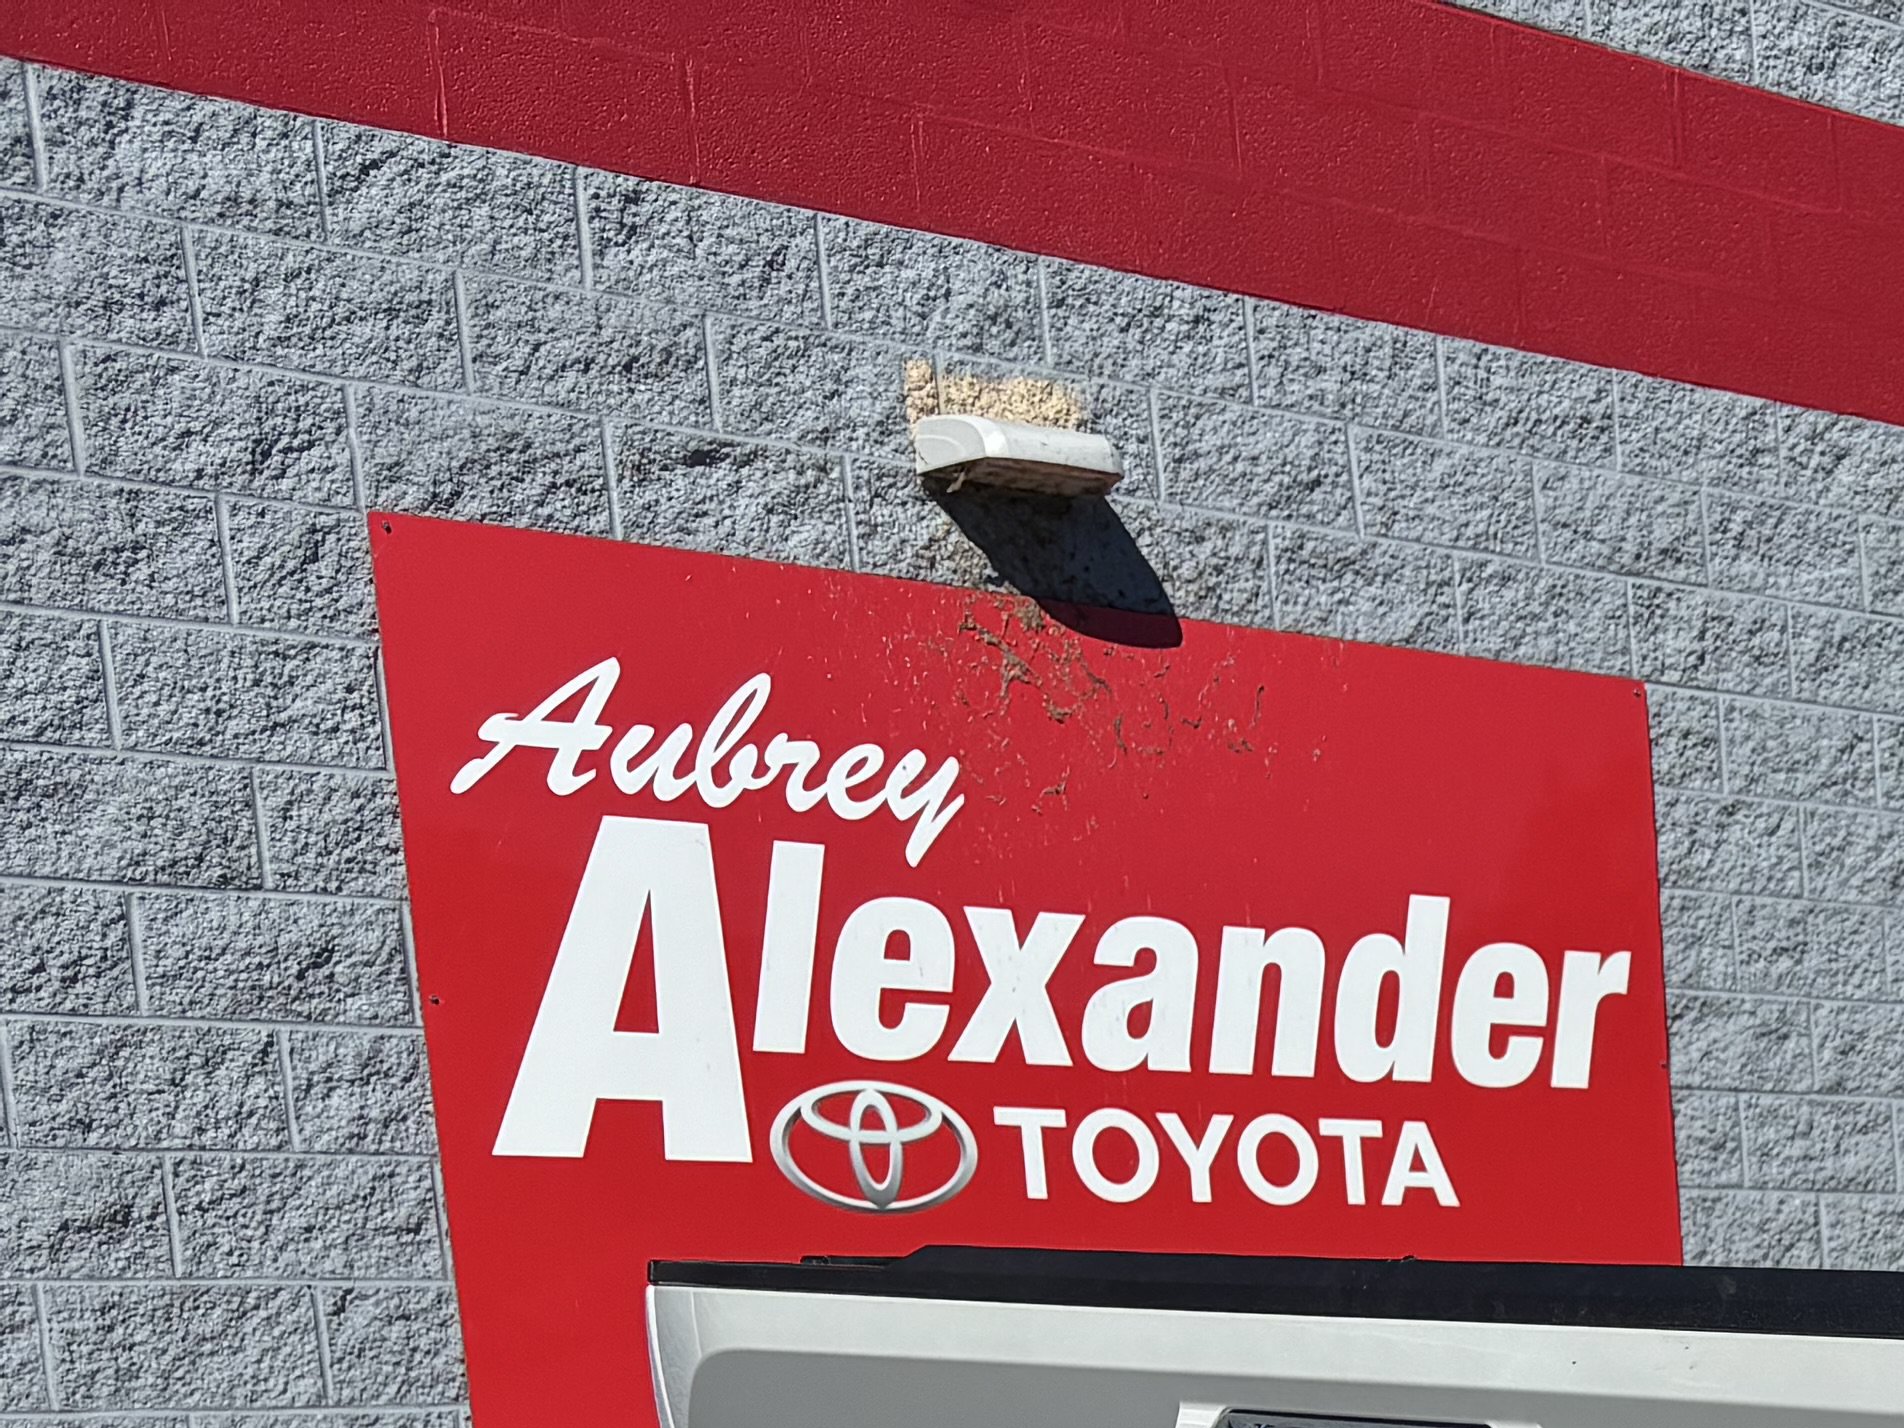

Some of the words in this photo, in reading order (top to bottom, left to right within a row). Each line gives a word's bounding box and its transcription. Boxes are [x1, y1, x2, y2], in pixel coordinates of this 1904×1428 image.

[450, 656, 966, 867] Aubrey
[491, 813, 1632, 1165] Alexander
[993, 1105, 1460, 1209] TOYOTA
